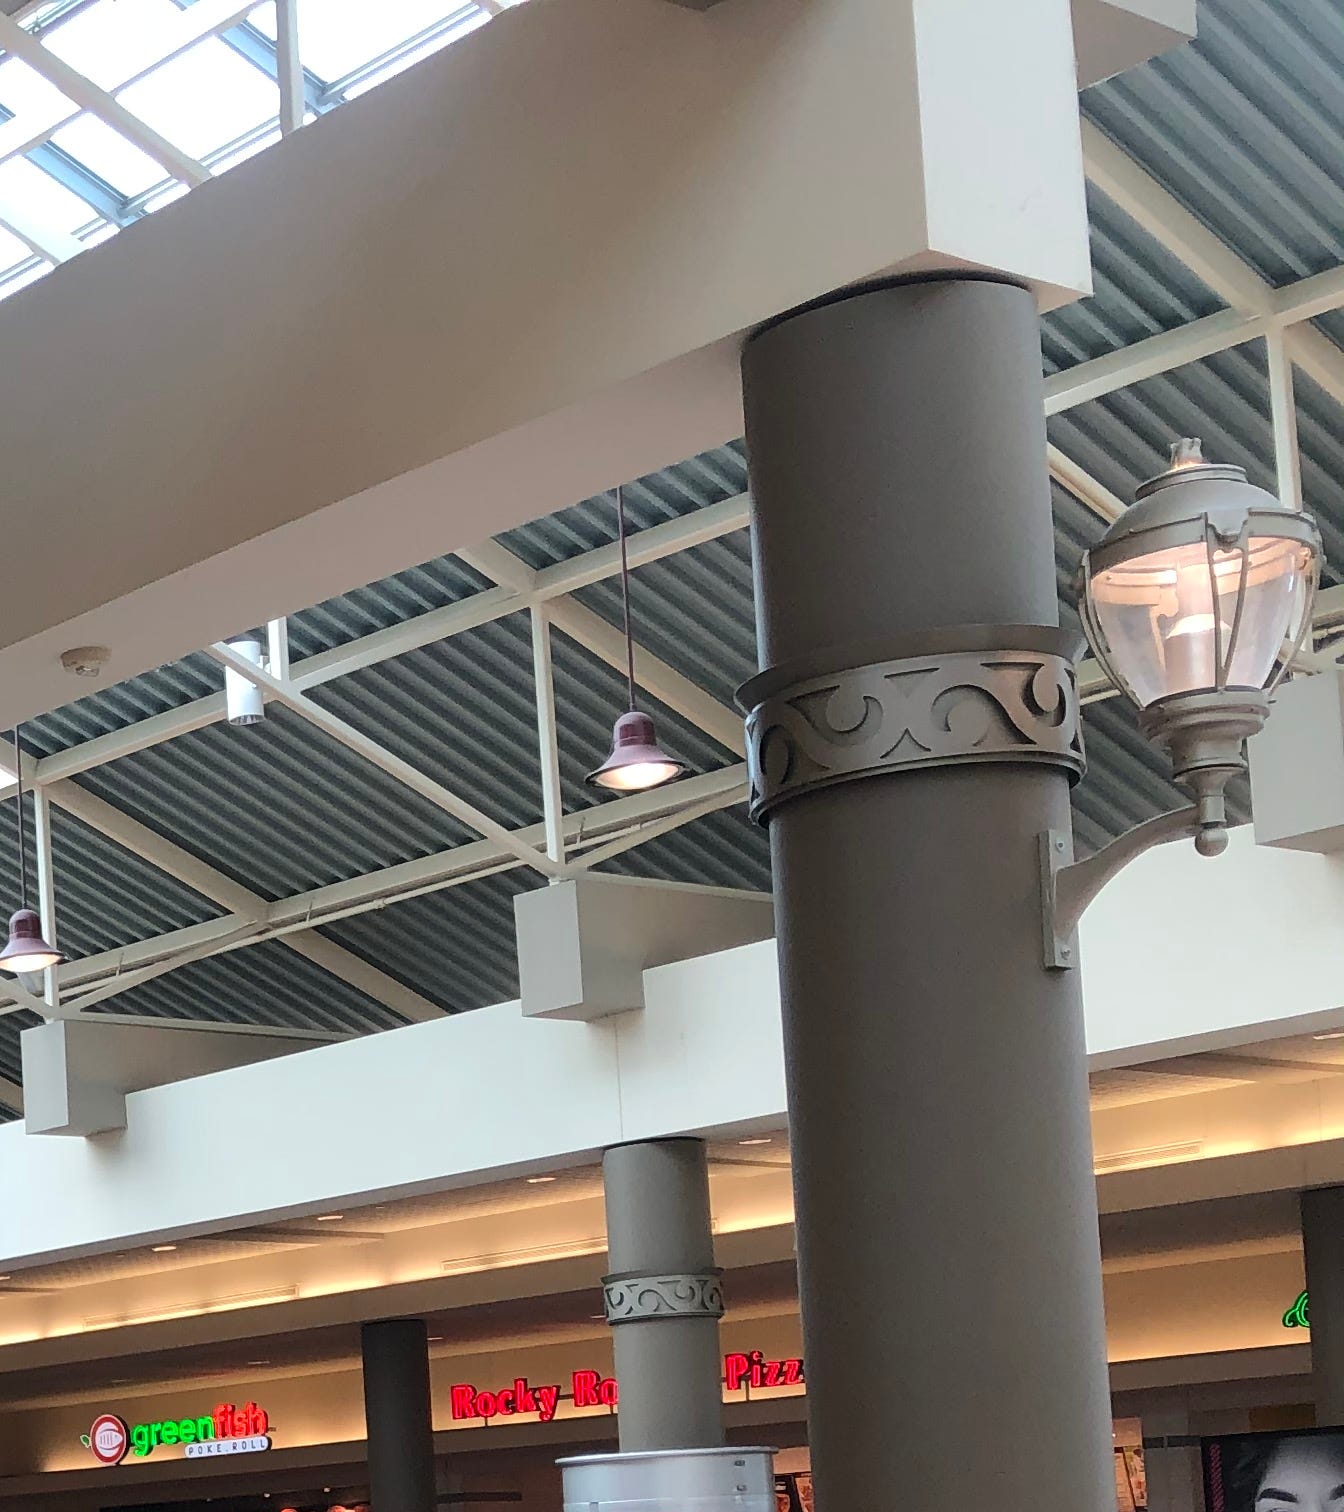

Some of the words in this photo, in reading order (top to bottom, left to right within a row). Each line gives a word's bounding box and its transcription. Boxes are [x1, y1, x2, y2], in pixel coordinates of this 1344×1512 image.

[451, 1383, 560, 1421] Rocky
[572, 1370, 618, 1407] Ro
[724, 1351, 804, 1391] Pizz
[131, 1402, 269, 1457] greenfish
